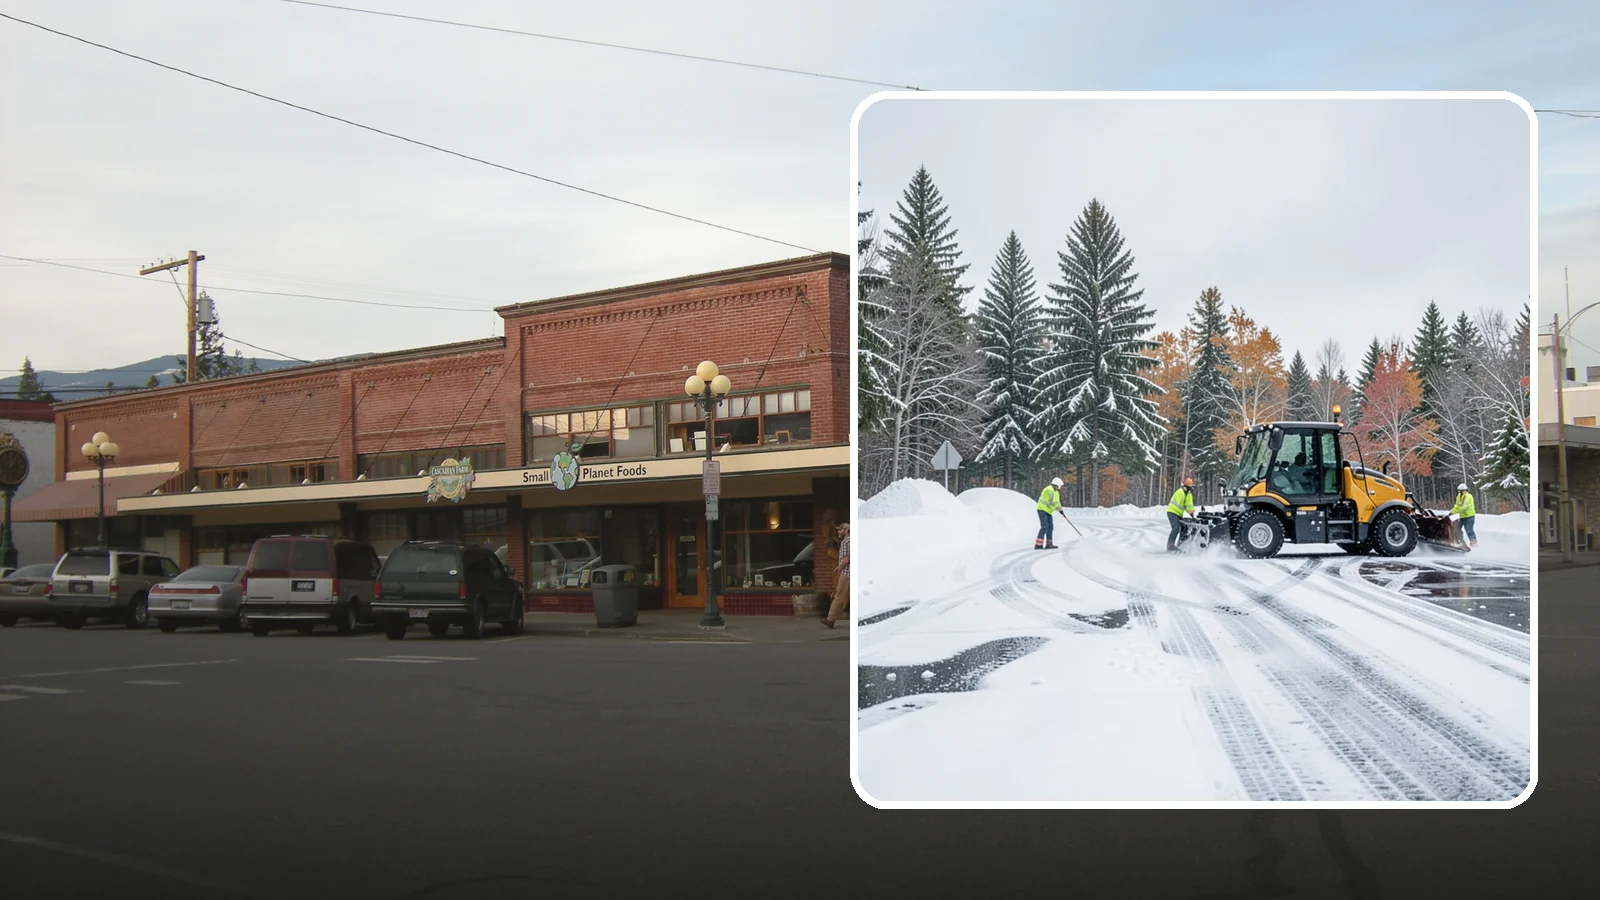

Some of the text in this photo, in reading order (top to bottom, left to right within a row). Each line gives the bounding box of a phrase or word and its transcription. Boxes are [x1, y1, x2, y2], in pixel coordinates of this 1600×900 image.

[523, 464, 647, 483] Small Planet Foods
